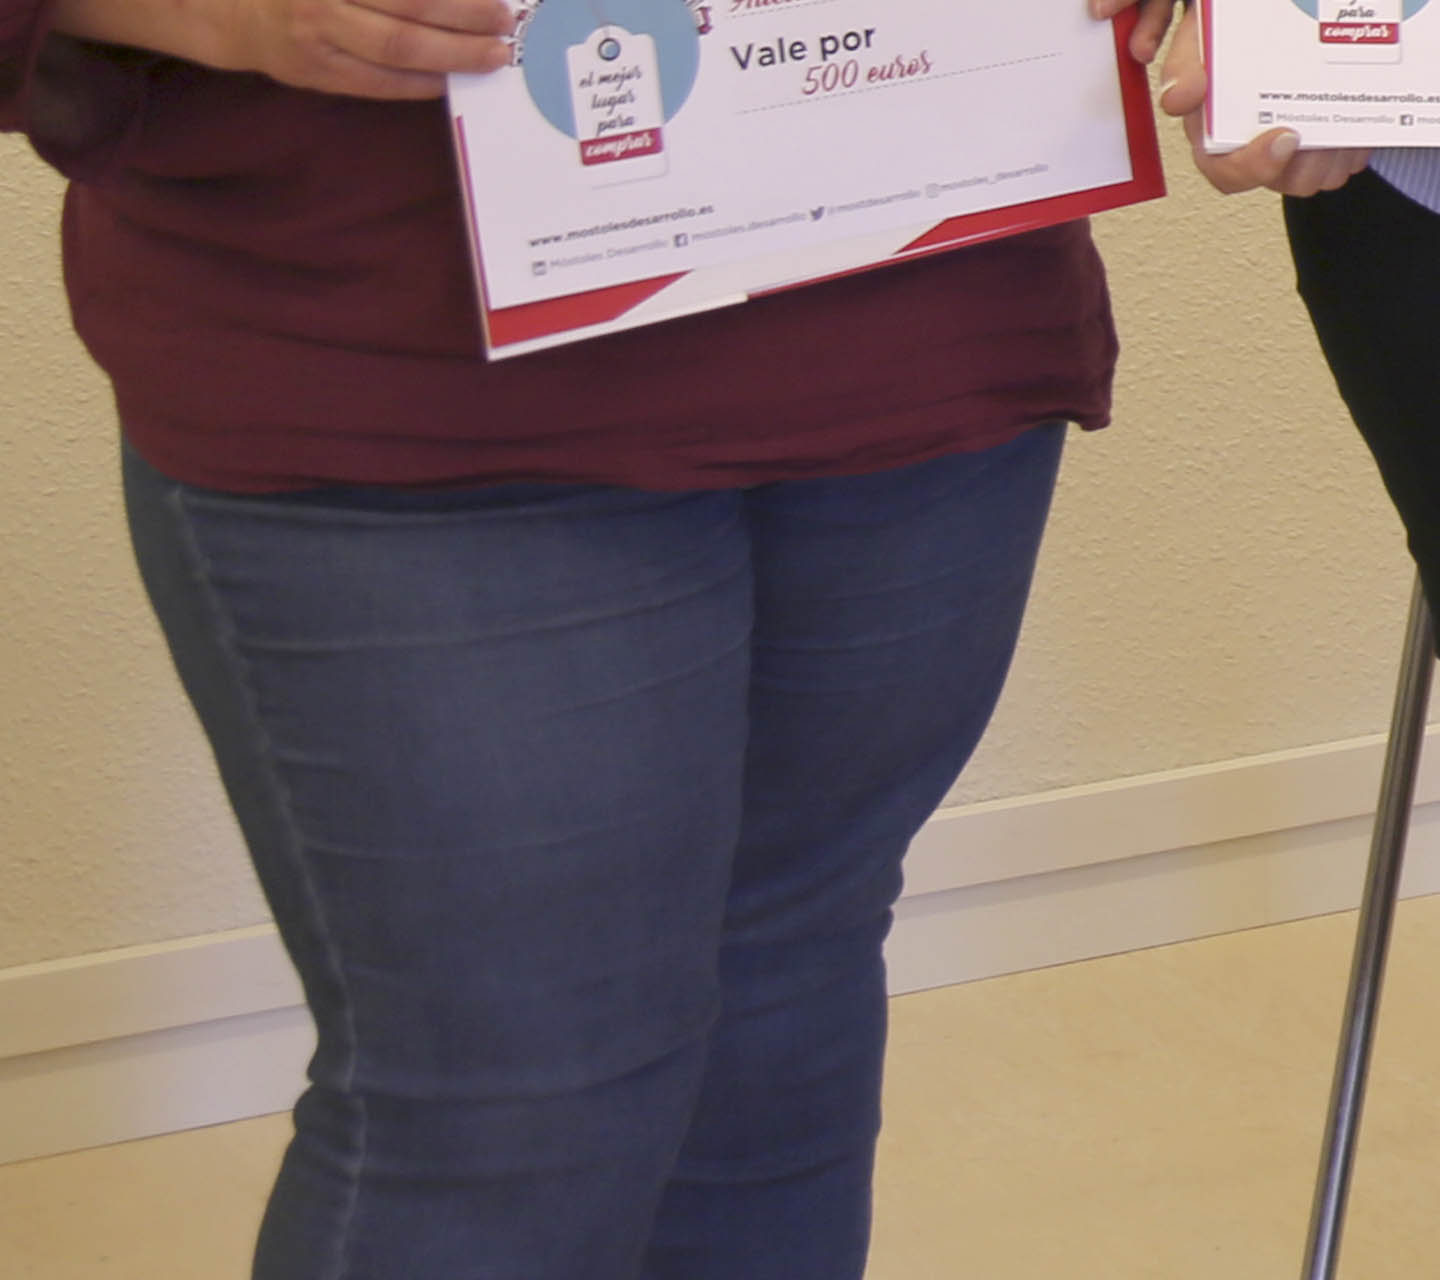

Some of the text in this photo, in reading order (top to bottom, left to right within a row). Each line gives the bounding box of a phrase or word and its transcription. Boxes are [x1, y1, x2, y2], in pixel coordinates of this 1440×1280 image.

[1336, 6, 1376, 23] para
[1324, 24, 1390, 42] comprar
[730, 27, 876, 71] Vale por
[579, 65, 642, 92] el mejor
[802, 49, 935, 96] 500 euros
[591, 88, 636, 117] lugar
[596, 114, 635, 138] para
[585, 132, 653, 158] comprar
[529, 203, 715, 247] www.mostolesdesarrollo.es
